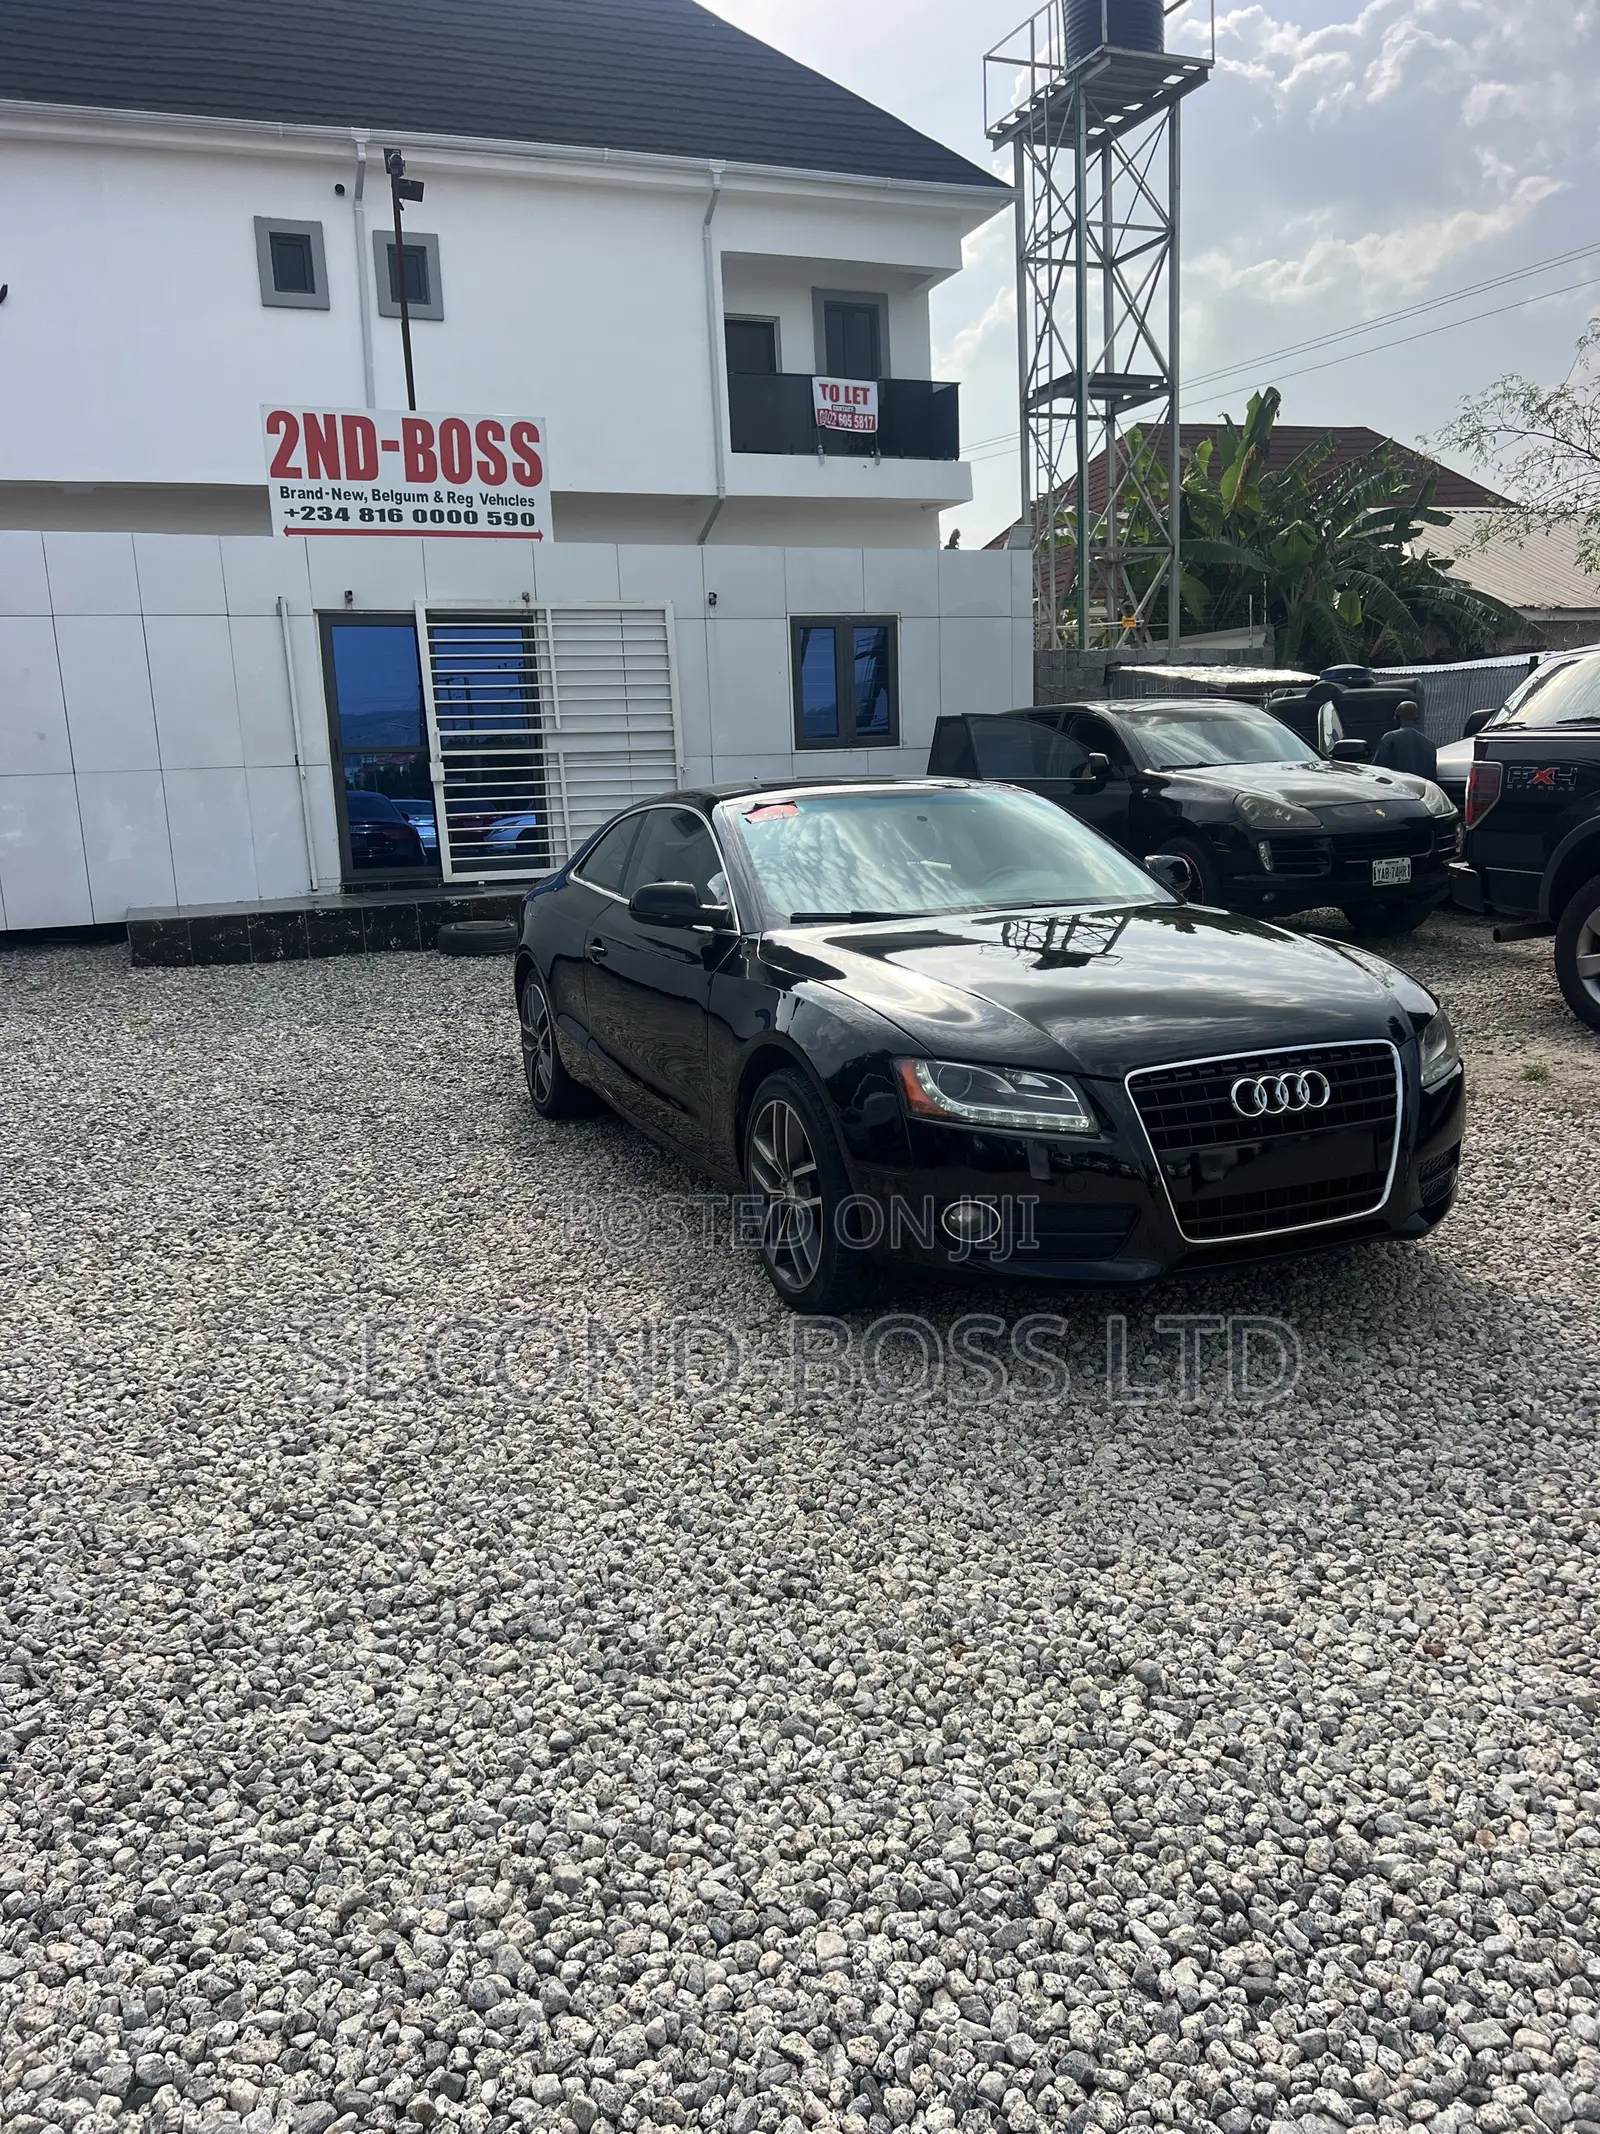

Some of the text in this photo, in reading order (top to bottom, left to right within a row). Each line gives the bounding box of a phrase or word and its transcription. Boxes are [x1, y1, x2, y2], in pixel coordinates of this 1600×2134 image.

[819, 384, 870, 405] TO LET
[854, 415, 874, 430] 5817
[266, 410, 543, 487] 2ND-BOSS
[280, 485, 368, 503] Brand-New,
[433, 490, 444, 503] &
[447, 491, 473, 507] Reg
[479, 493, 535, 507] Vehicles
[284, 505, 535, 526] +234 816 0000 590
